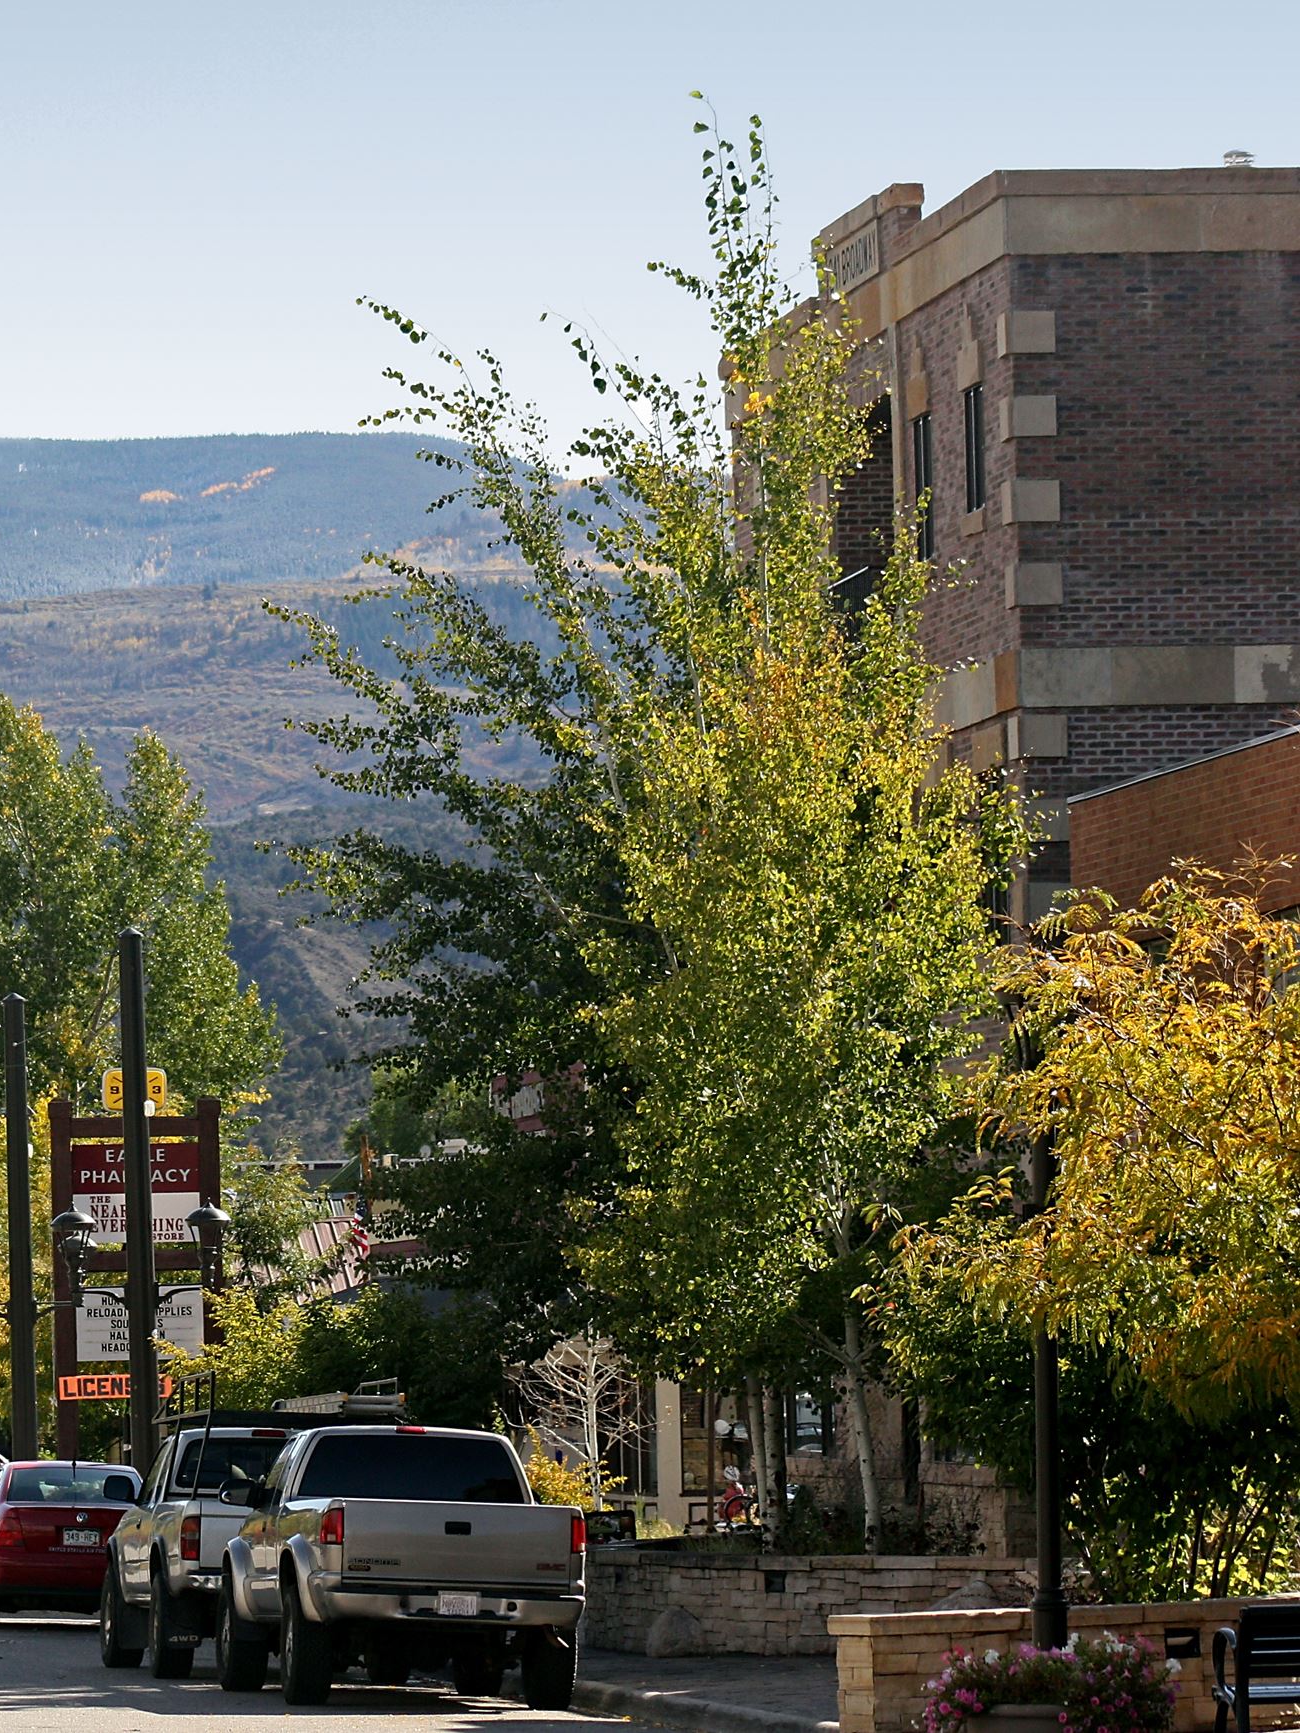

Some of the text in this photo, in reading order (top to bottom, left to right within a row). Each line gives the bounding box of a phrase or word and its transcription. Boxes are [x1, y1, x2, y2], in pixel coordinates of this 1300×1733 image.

[110, 1085, 120, 1095] 9
[152, 1085, 161, 1094] 3
[105, 1148, 165, 1163] EAE
[80, 1168, 191, 1184] PHAACY
[89, 1195, 111, 1204] THE
[86, 1306, 193, 1318] RELOADI PPLIES
